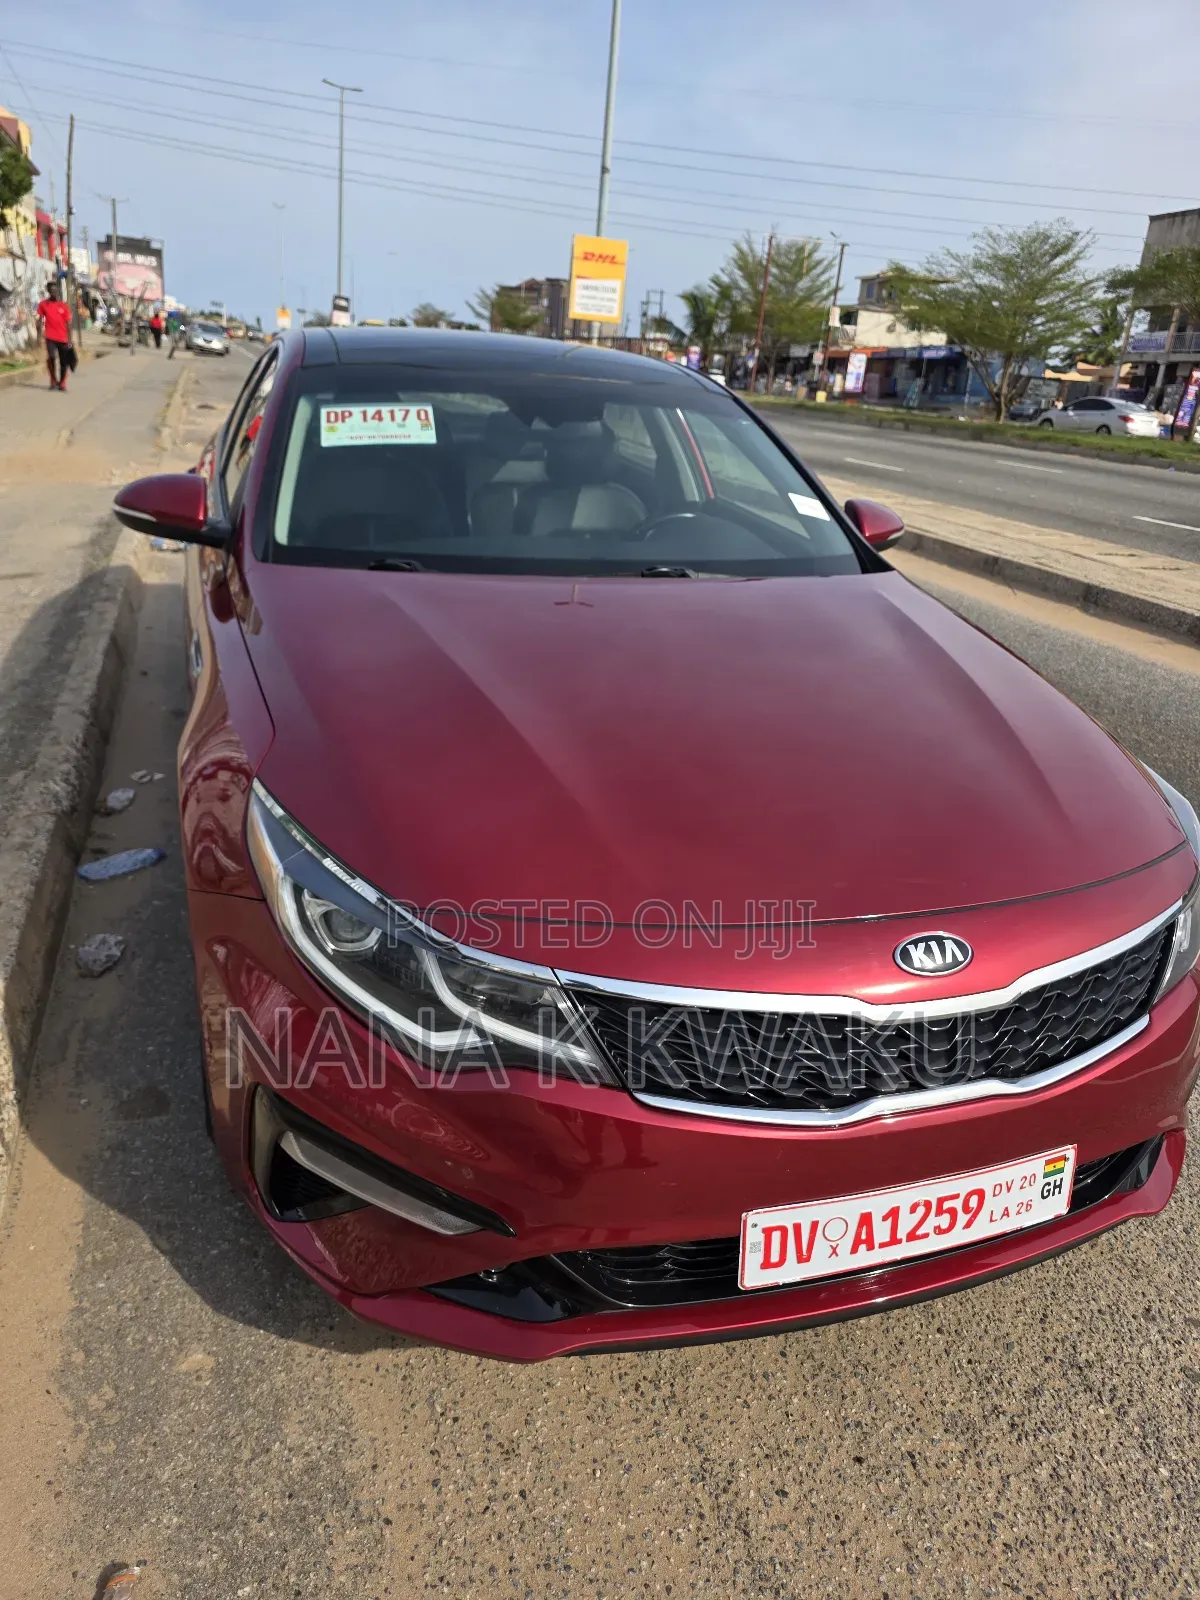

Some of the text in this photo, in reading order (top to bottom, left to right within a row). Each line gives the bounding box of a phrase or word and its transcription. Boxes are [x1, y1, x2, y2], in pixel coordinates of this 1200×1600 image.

[583, 252, 618, 264] DHL
[326, 411, 353, 424] DP
[360, 409, 410, 423] 1417
[905, 938, 965, 970] KIA
[992, 1172, 1037, 1198] DV 20
[1040, 1177, 1064, 1200] GH
[989, 1199, 1034, 1224] LA 26
[760, 1219, 820, 1270] DV
[849, 1187, 986, 1255] A1259
